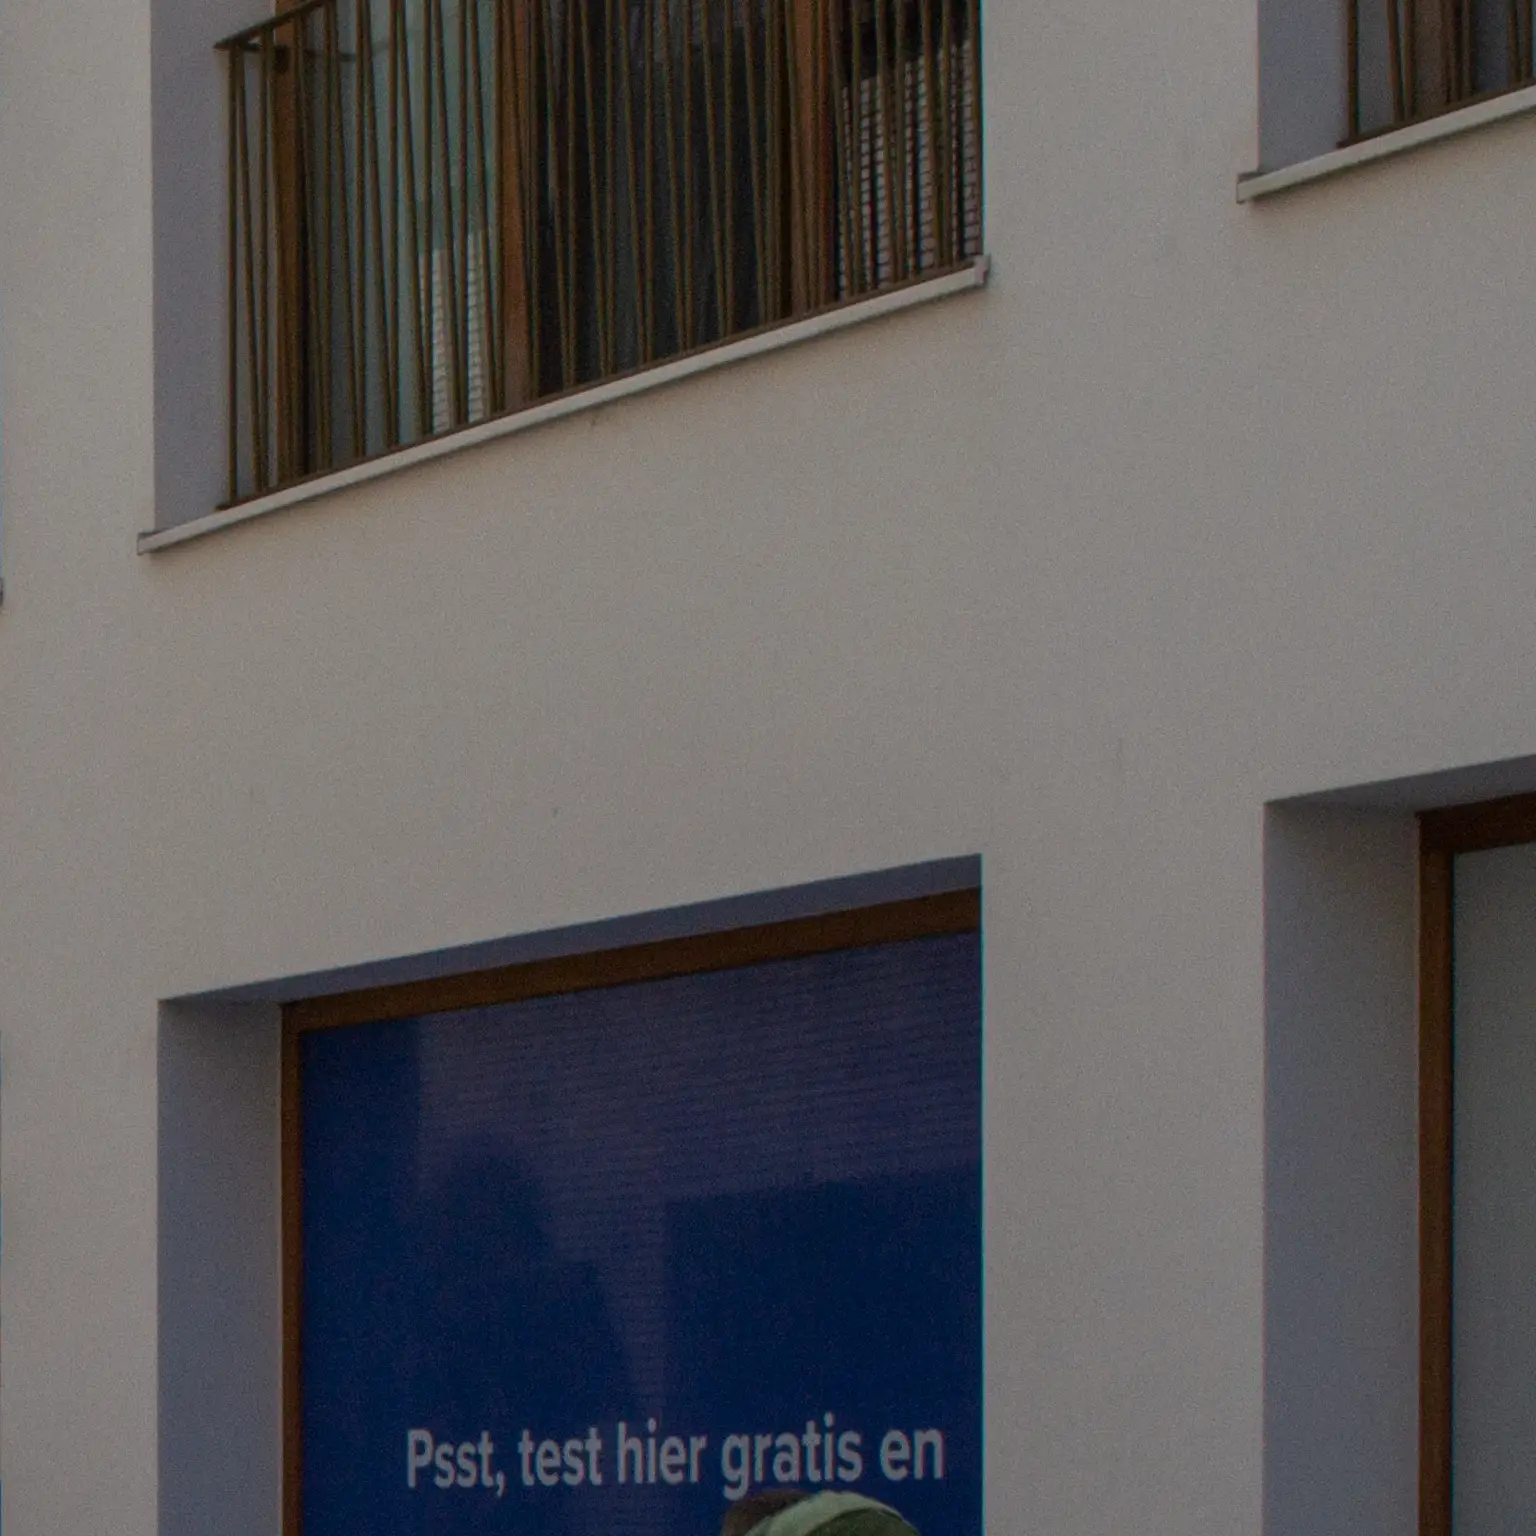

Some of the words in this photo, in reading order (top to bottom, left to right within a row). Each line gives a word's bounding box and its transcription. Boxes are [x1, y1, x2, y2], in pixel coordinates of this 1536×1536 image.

[407, 1428, 506, 1497] Psst,
[518, 1427, 603, 1487] test
[617, 1417, 708, 1485] hier
[722, 1412, 863, 1500] gratis
[880, 1427, 945, 1482] en
